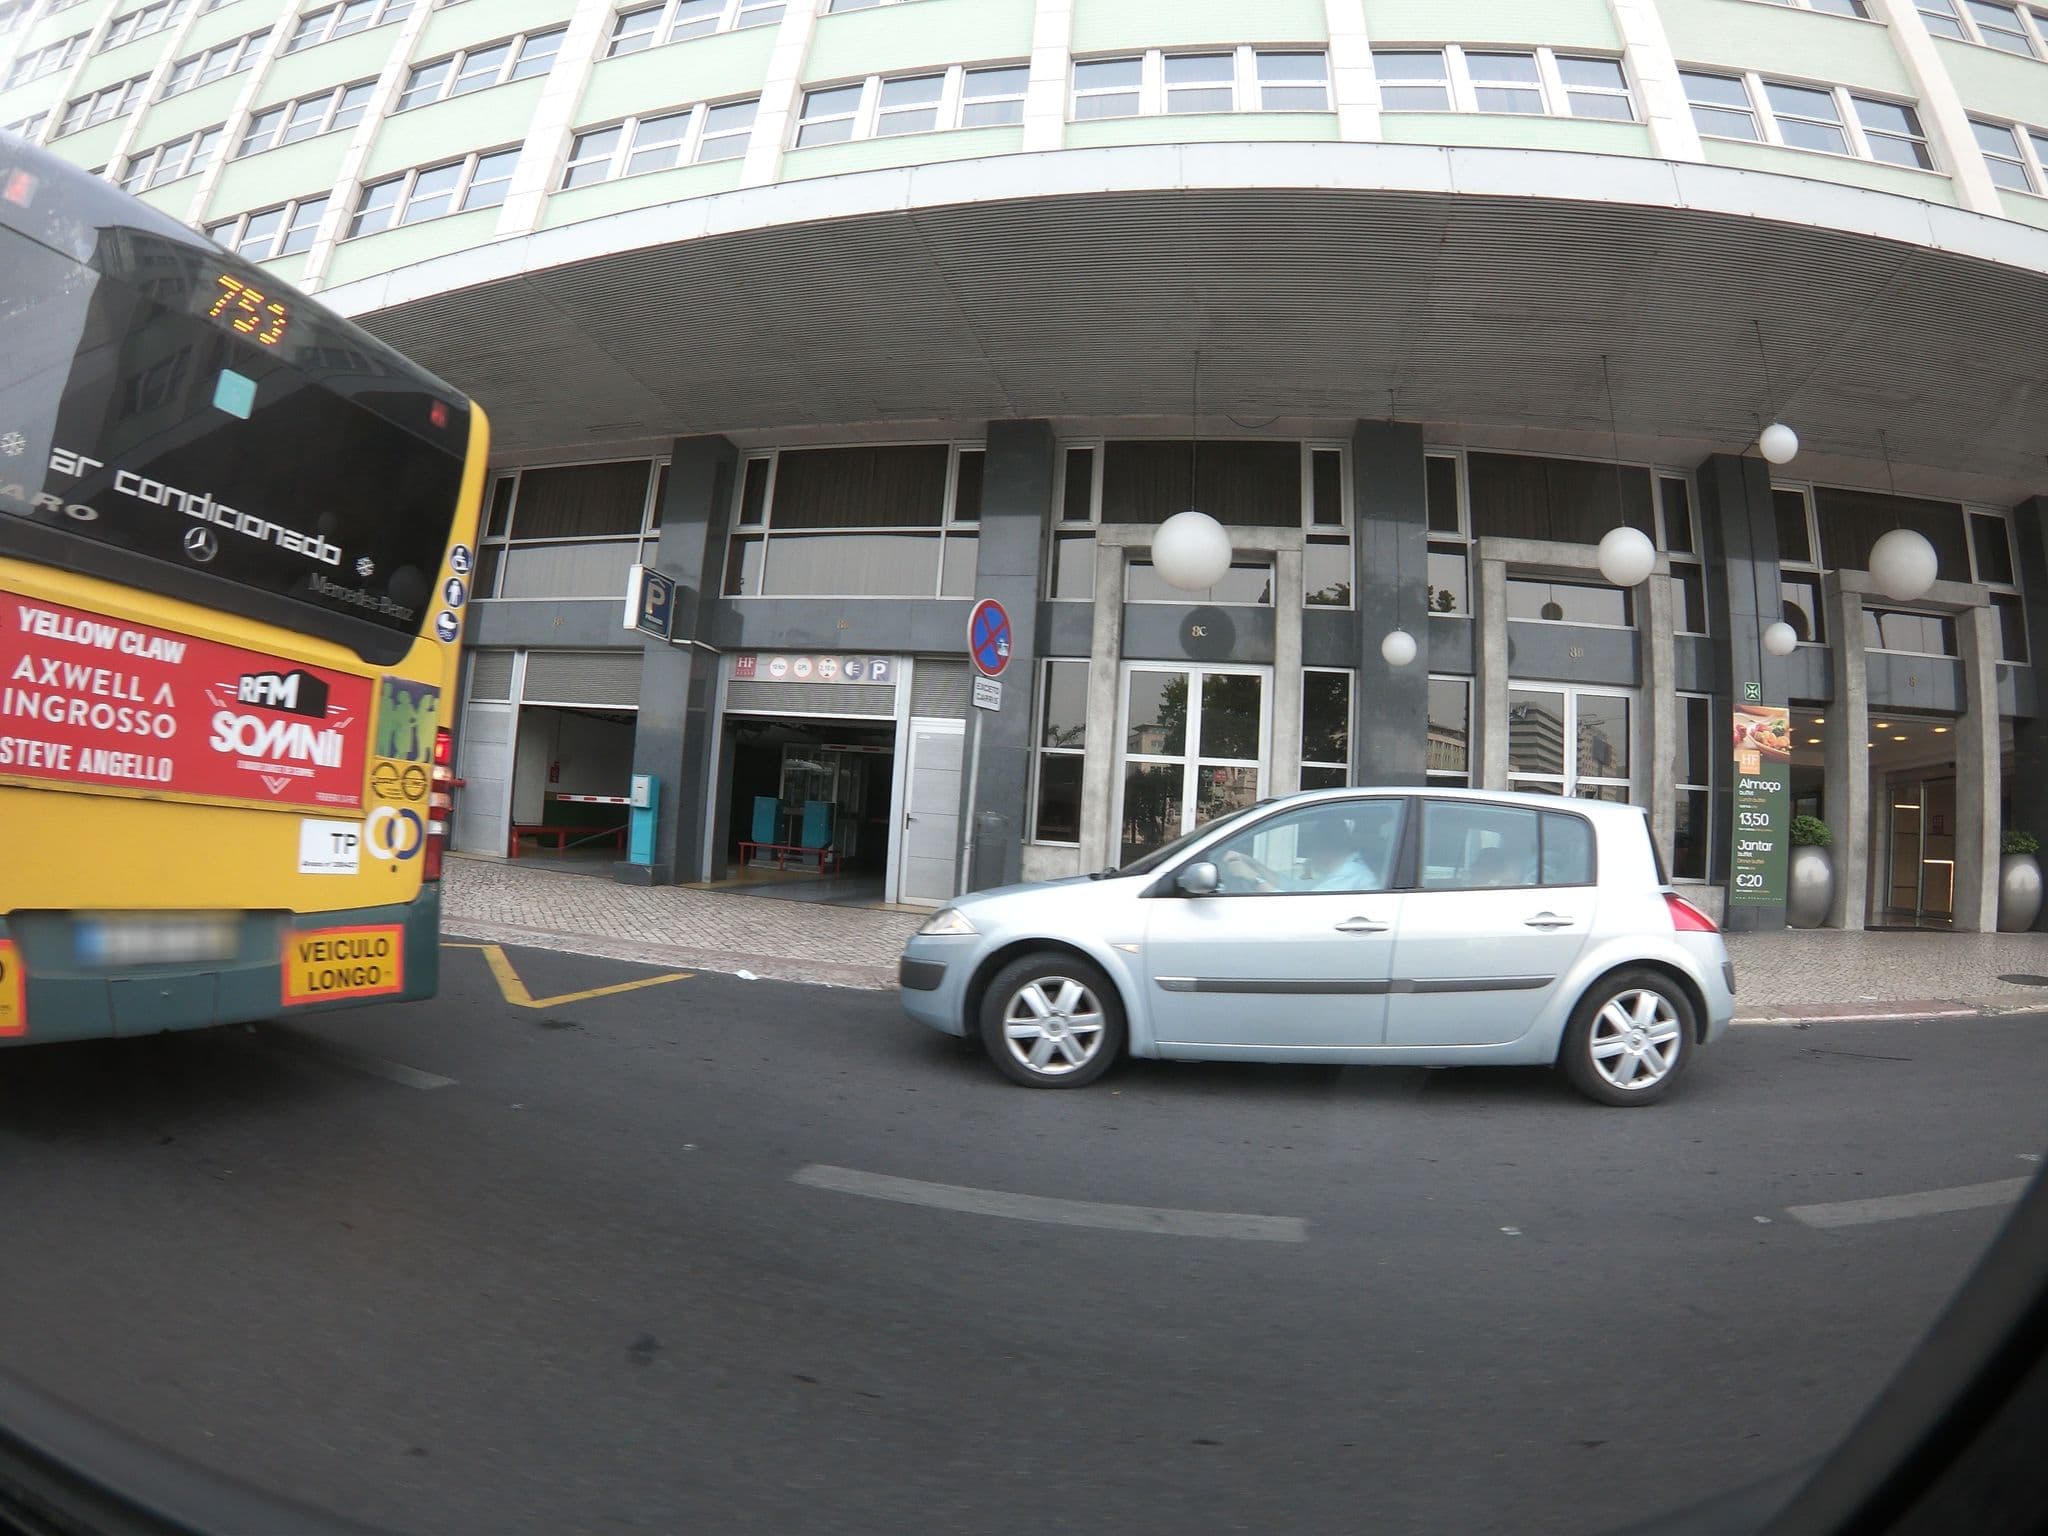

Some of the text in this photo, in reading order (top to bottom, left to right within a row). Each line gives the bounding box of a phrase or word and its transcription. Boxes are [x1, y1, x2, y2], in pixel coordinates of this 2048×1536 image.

[209, 274, 286, 345] 753
[50, 447, 342, 566] ar condicionado
[18, 606, 187, 664] YELLOW CLAW
[1191, 625, 1208, 637] 8C
[738, 656, 755, 668] HF
[12, 654, 145, 702] AXWELL
[238, 674, 301, 709] RFM
[2, 687, 177, 739] INGROSSO
[0, 736, 174, 782] STEVE ANGELLO
[1742, 753, 1760, 764] HF
[1738, 778, 1781, 793] Almoço
[1738, 812, 1769, 827] 13,50
[330, 832, 358, 854] TP
[1737, 839, 1773, 852] Jantar
[1736, 873, 1763, 887] €20
[298, 938, 389, 963] VEICULO
[308, 965, 381, 991] LONGO
